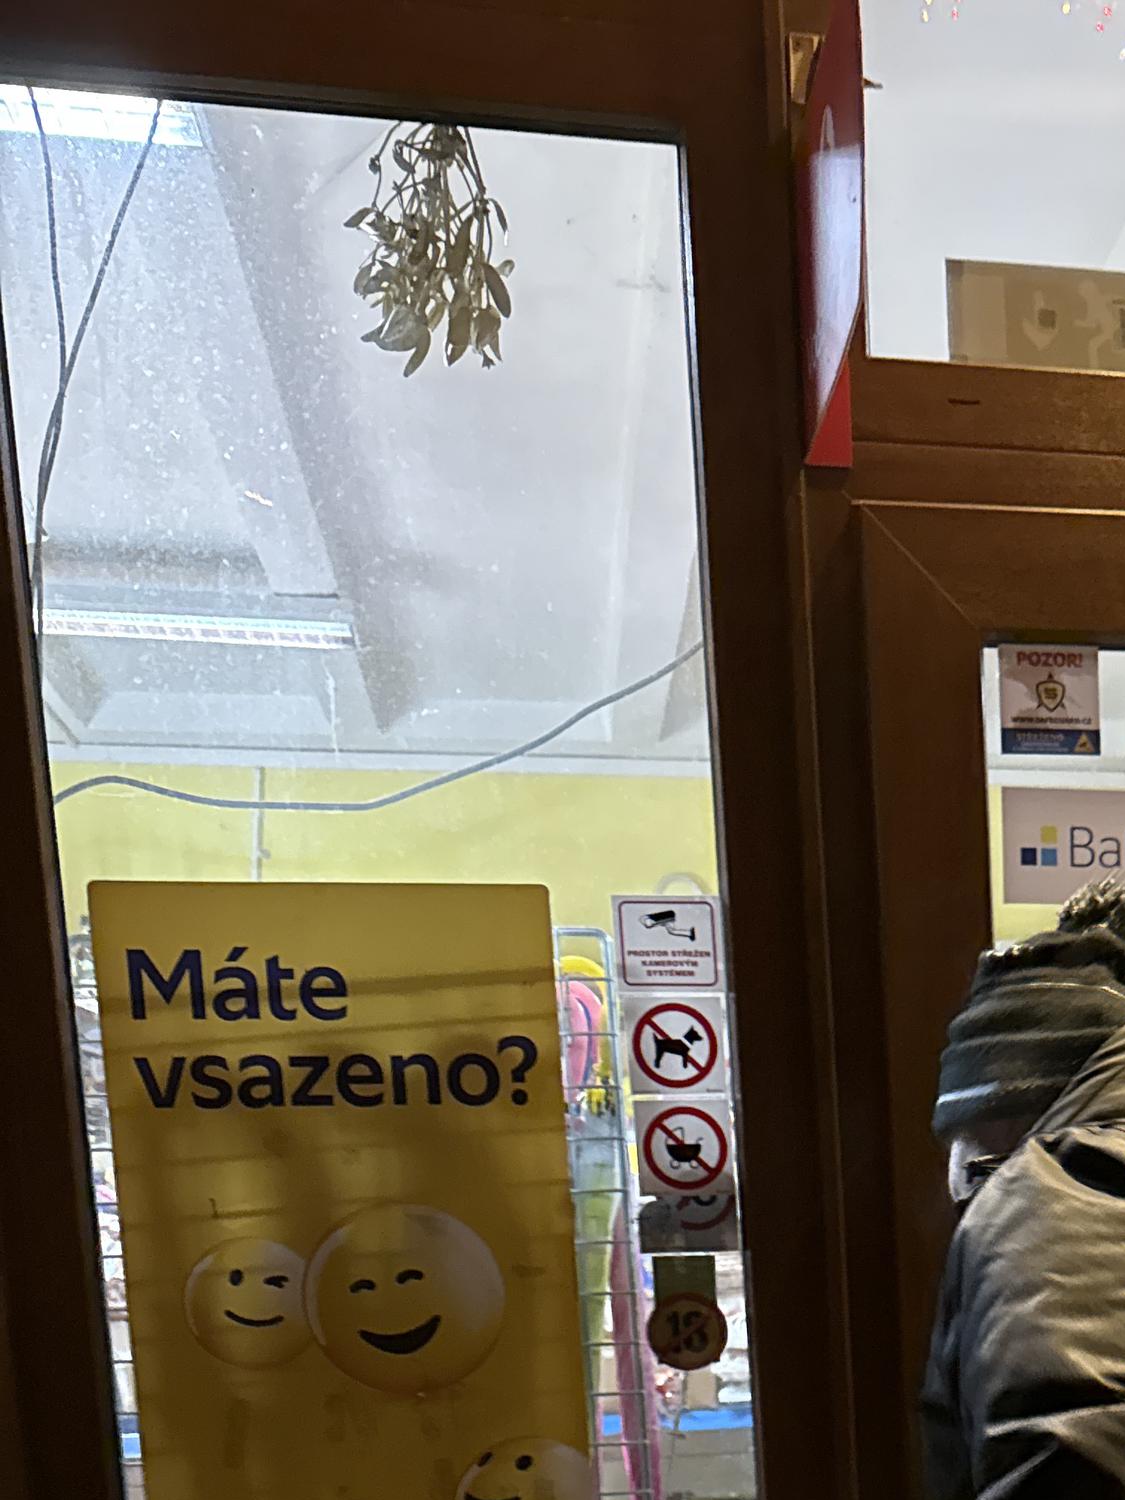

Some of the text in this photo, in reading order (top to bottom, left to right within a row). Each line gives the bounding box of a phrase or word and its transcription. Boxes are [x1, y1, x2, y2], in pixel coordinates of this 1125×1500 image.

[1016, 651, 1083, 668] POZOR!
[126, 946, 349, 1021] Máte
[133, 1035, 538, 1109] vsazeno?
